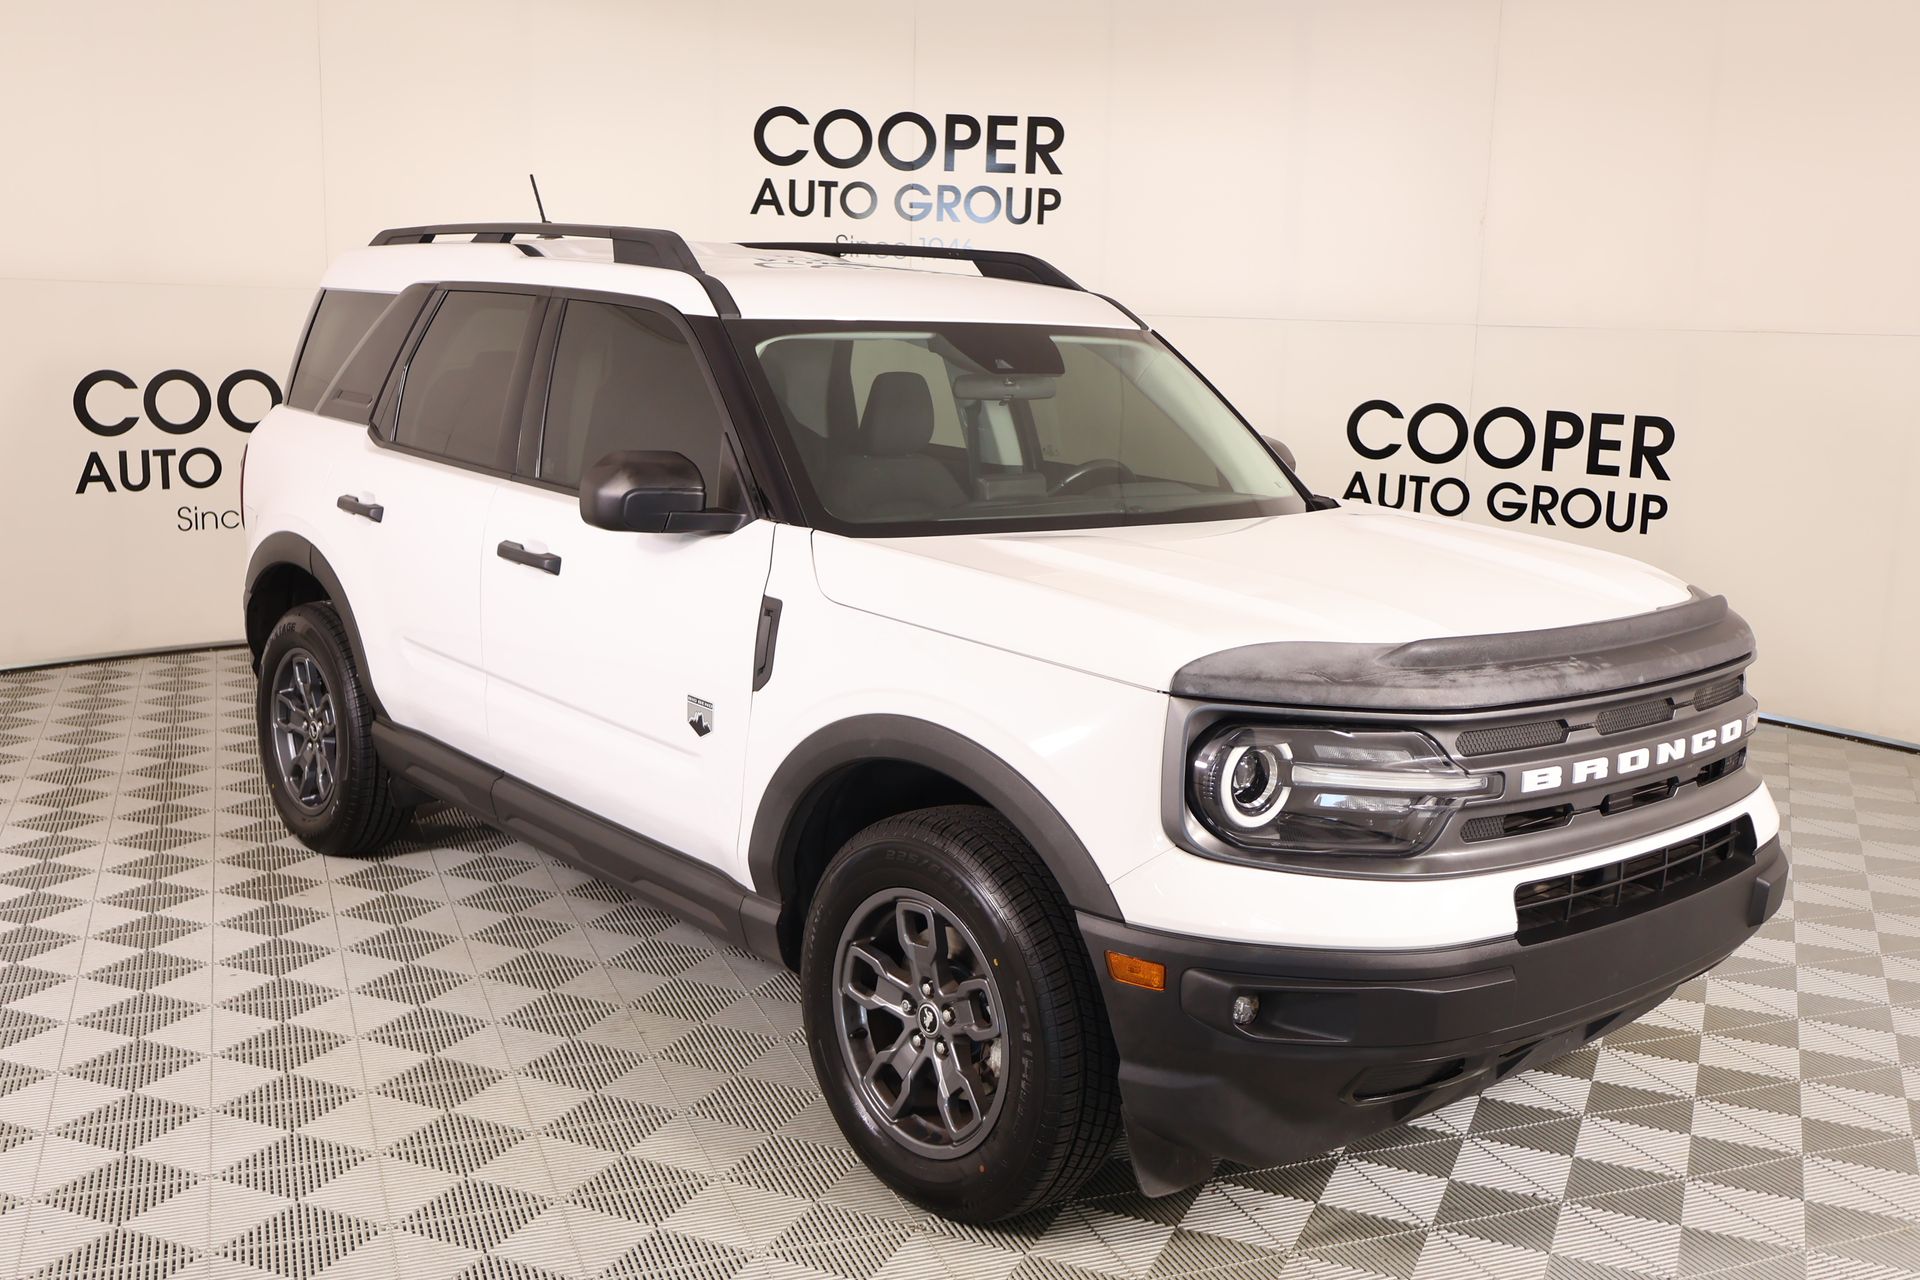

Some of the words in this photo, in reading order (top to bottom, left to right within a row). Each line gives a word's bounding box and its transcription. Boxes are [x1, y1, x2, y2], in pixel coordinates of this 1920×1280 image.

[754, 106, 1065, 175] COOPER
[750, 178, 878, 220] AUTO
[894, 183, 1062, 225] GROUP
[75, 447, 222, 495] AUTO
[1346, 399, 1676, 481] COOPER
[1343, 471, 1470, 517] AUTO
[1486, 482, 1668, 535] GROUP
[1520, 719, 1742, 793] BRONCO
